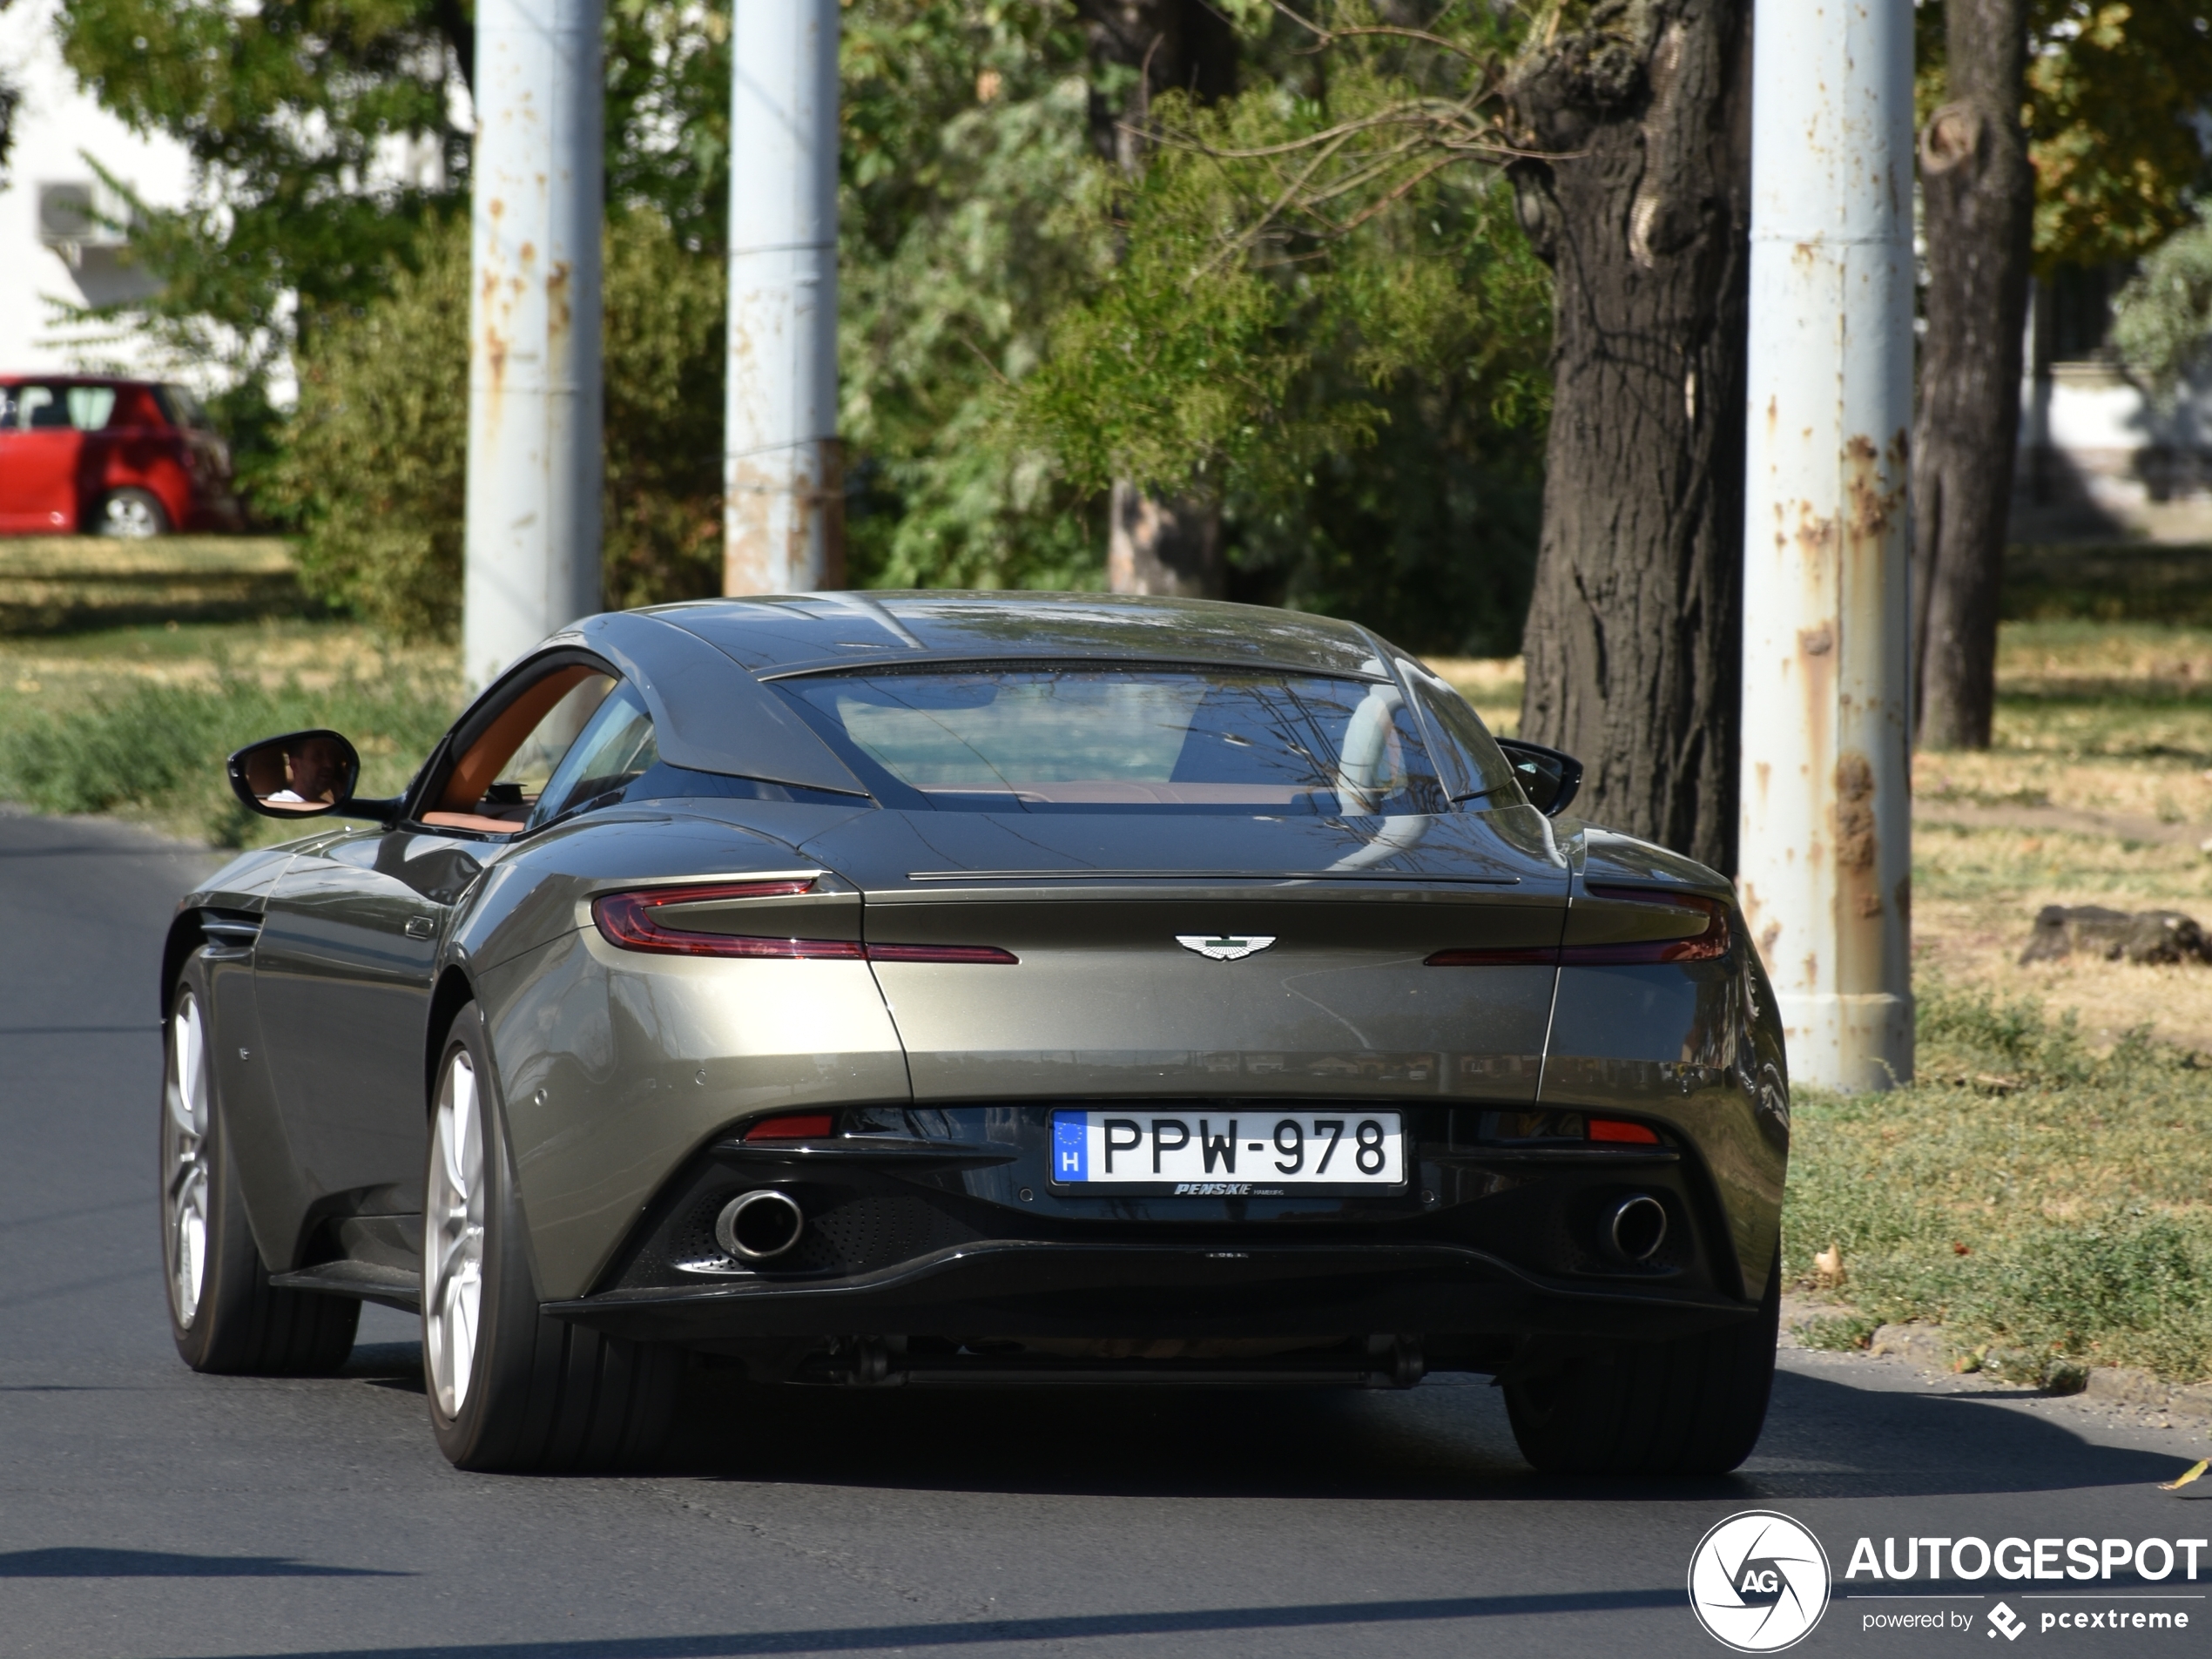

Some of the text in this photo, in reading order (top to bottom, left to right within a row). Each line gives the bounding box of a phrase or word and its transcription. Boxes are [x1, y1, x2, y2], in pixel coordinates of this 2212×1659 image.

[1103, 1118, 1386, 1175] PPW-978
[1062, 1151, 1079, 1171] H
[1174, 1184, 1252, 1196] PENSKE
